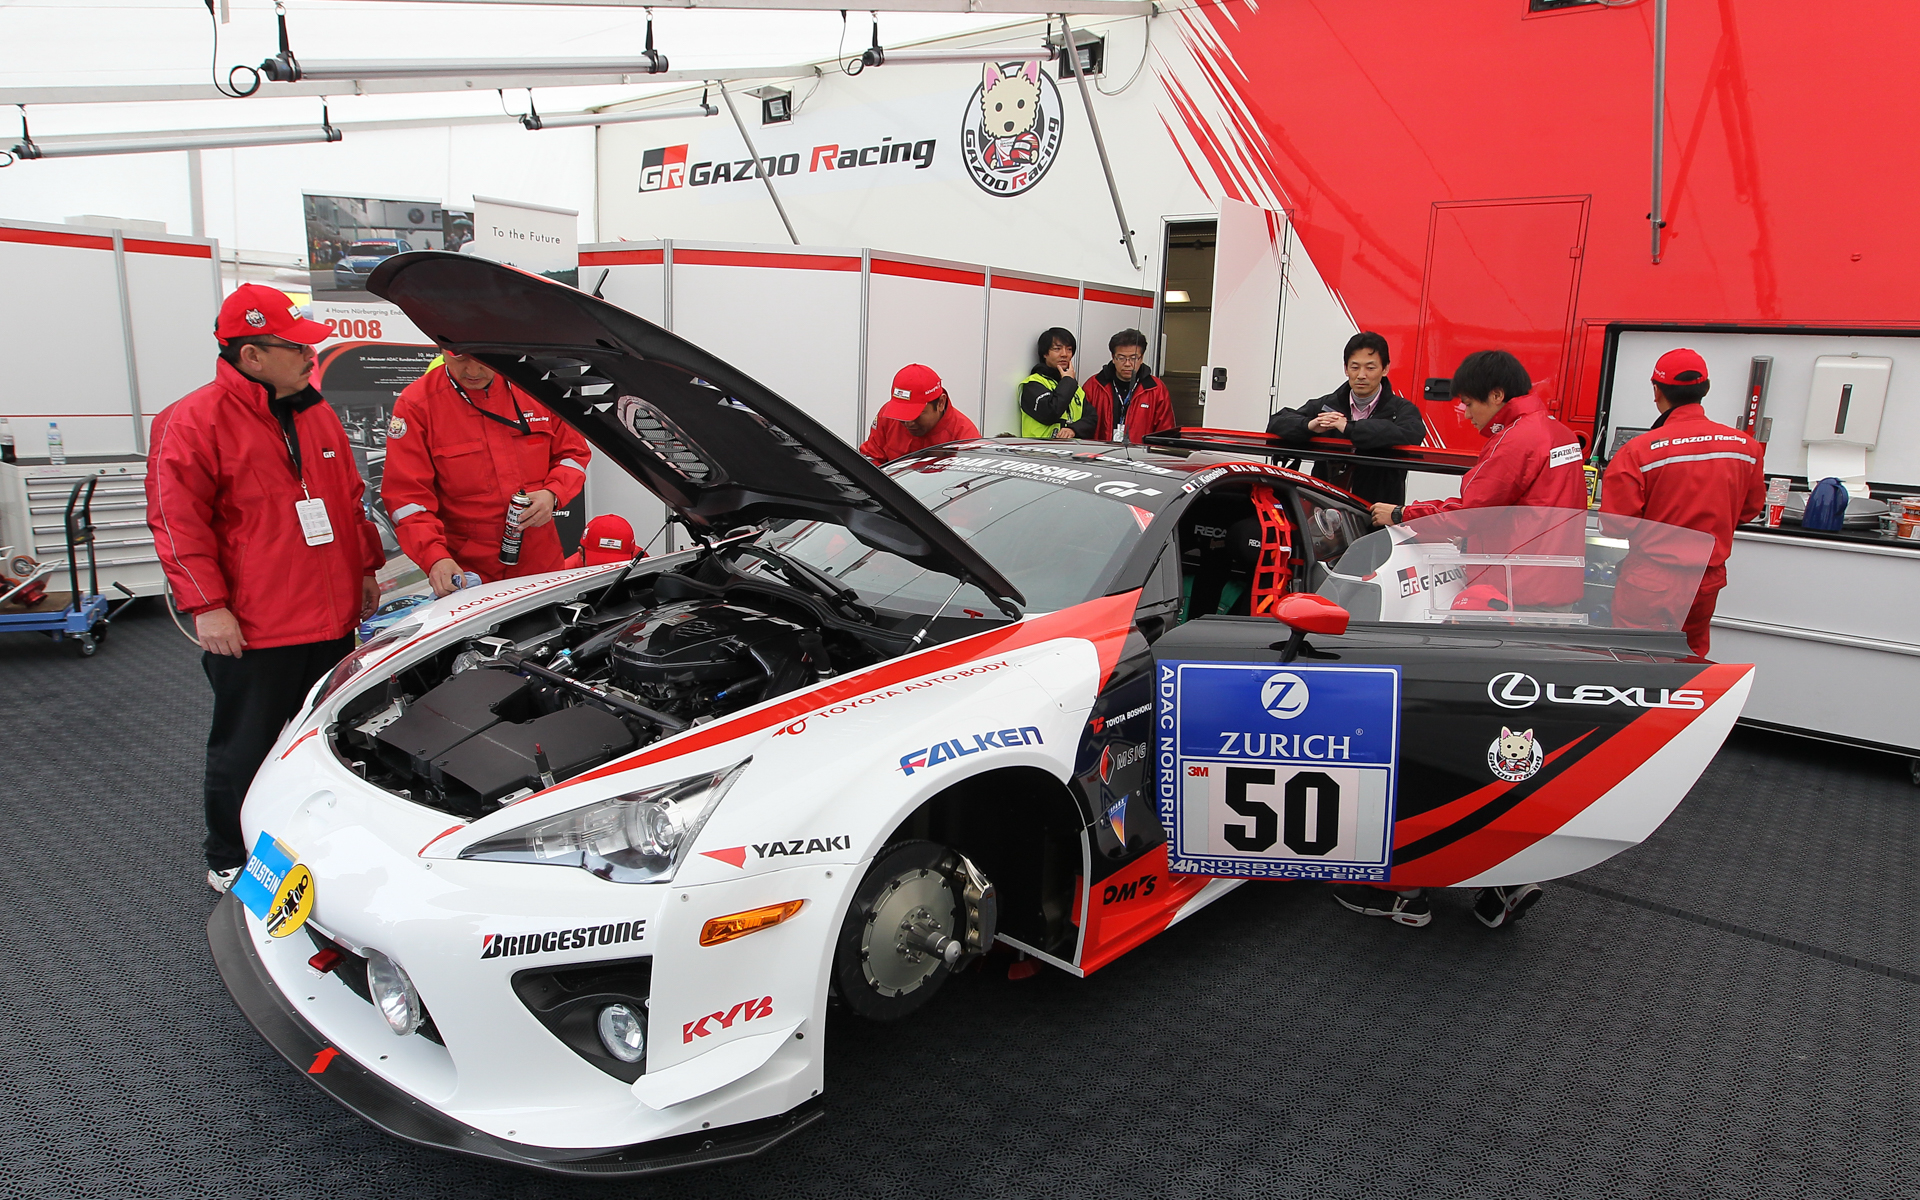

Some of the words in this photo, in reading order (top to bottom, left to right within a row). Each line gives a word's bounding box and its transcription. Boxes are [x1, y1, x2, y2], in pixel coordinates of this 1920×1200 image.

[639, 160, 686, 191] GR
[688, 152, 801, 187] GAZOO
[808, 136, 937, 173] Racing
[965, 128, 1008, 191] GAZOO
[1012, 116, 1060, 190] Racing
[492, 227, 505, 238] To
[509, 228, 525, 240] the
[529, 231, 561, 244] Future
[324, 318, 383, 339] 2008
[1748, 395, 1759, 425] CUPS
[323, 450, 336, 458] GR
[1650, 440, 1670, 451] GR
[1672, 435, 1712, 445] GAZOO
[1714, 434, 1747, 445] Racing
[934, 456, 999, 469] GRAN
[999, 460, 1093, 481] TURISMO
[967, 466, 1007, 475] DRIVING
[1007, 471, 1069, 486] SIMULATOR
[1420, 568, 1463, 591] GAZOO
[814, 690, 904, 719] TOYOTA
[905, 674, 960, 692] AUTO
[958, 660, 1010, 678] BODY
[1160, 665, 1175, 730] ADAC
[1546, 683, 1705, 710] LEXUS
[1105, 714, 1126, 728] TOYOTA
[1126, 702, 1152, 720] BOSHOKU
[896, 725, 1044, 776] FALKEN
[1116, 741, 1147, 770] MSIG
[1218, 732, 1351, 760] ZURICH
[1187, 766, 1209, 777] 3M
[1489, 752, 1512, 780] GAZOO
[1513, 755, 1542, 780] Racing
[1223, 766, 1340, 856] 50
[752, 834, 851, 859] YAZAKI
[245, 855, 281, 895] BILSTEIN
[1200, 860, 1385, 874] NÜRBURGRING
[1200, 867, 1384, 880] NORDSCHLEIFE
[480, 919, 647, 959] BRIDGESTONE
[682, 995, 773, 1044] KYB
